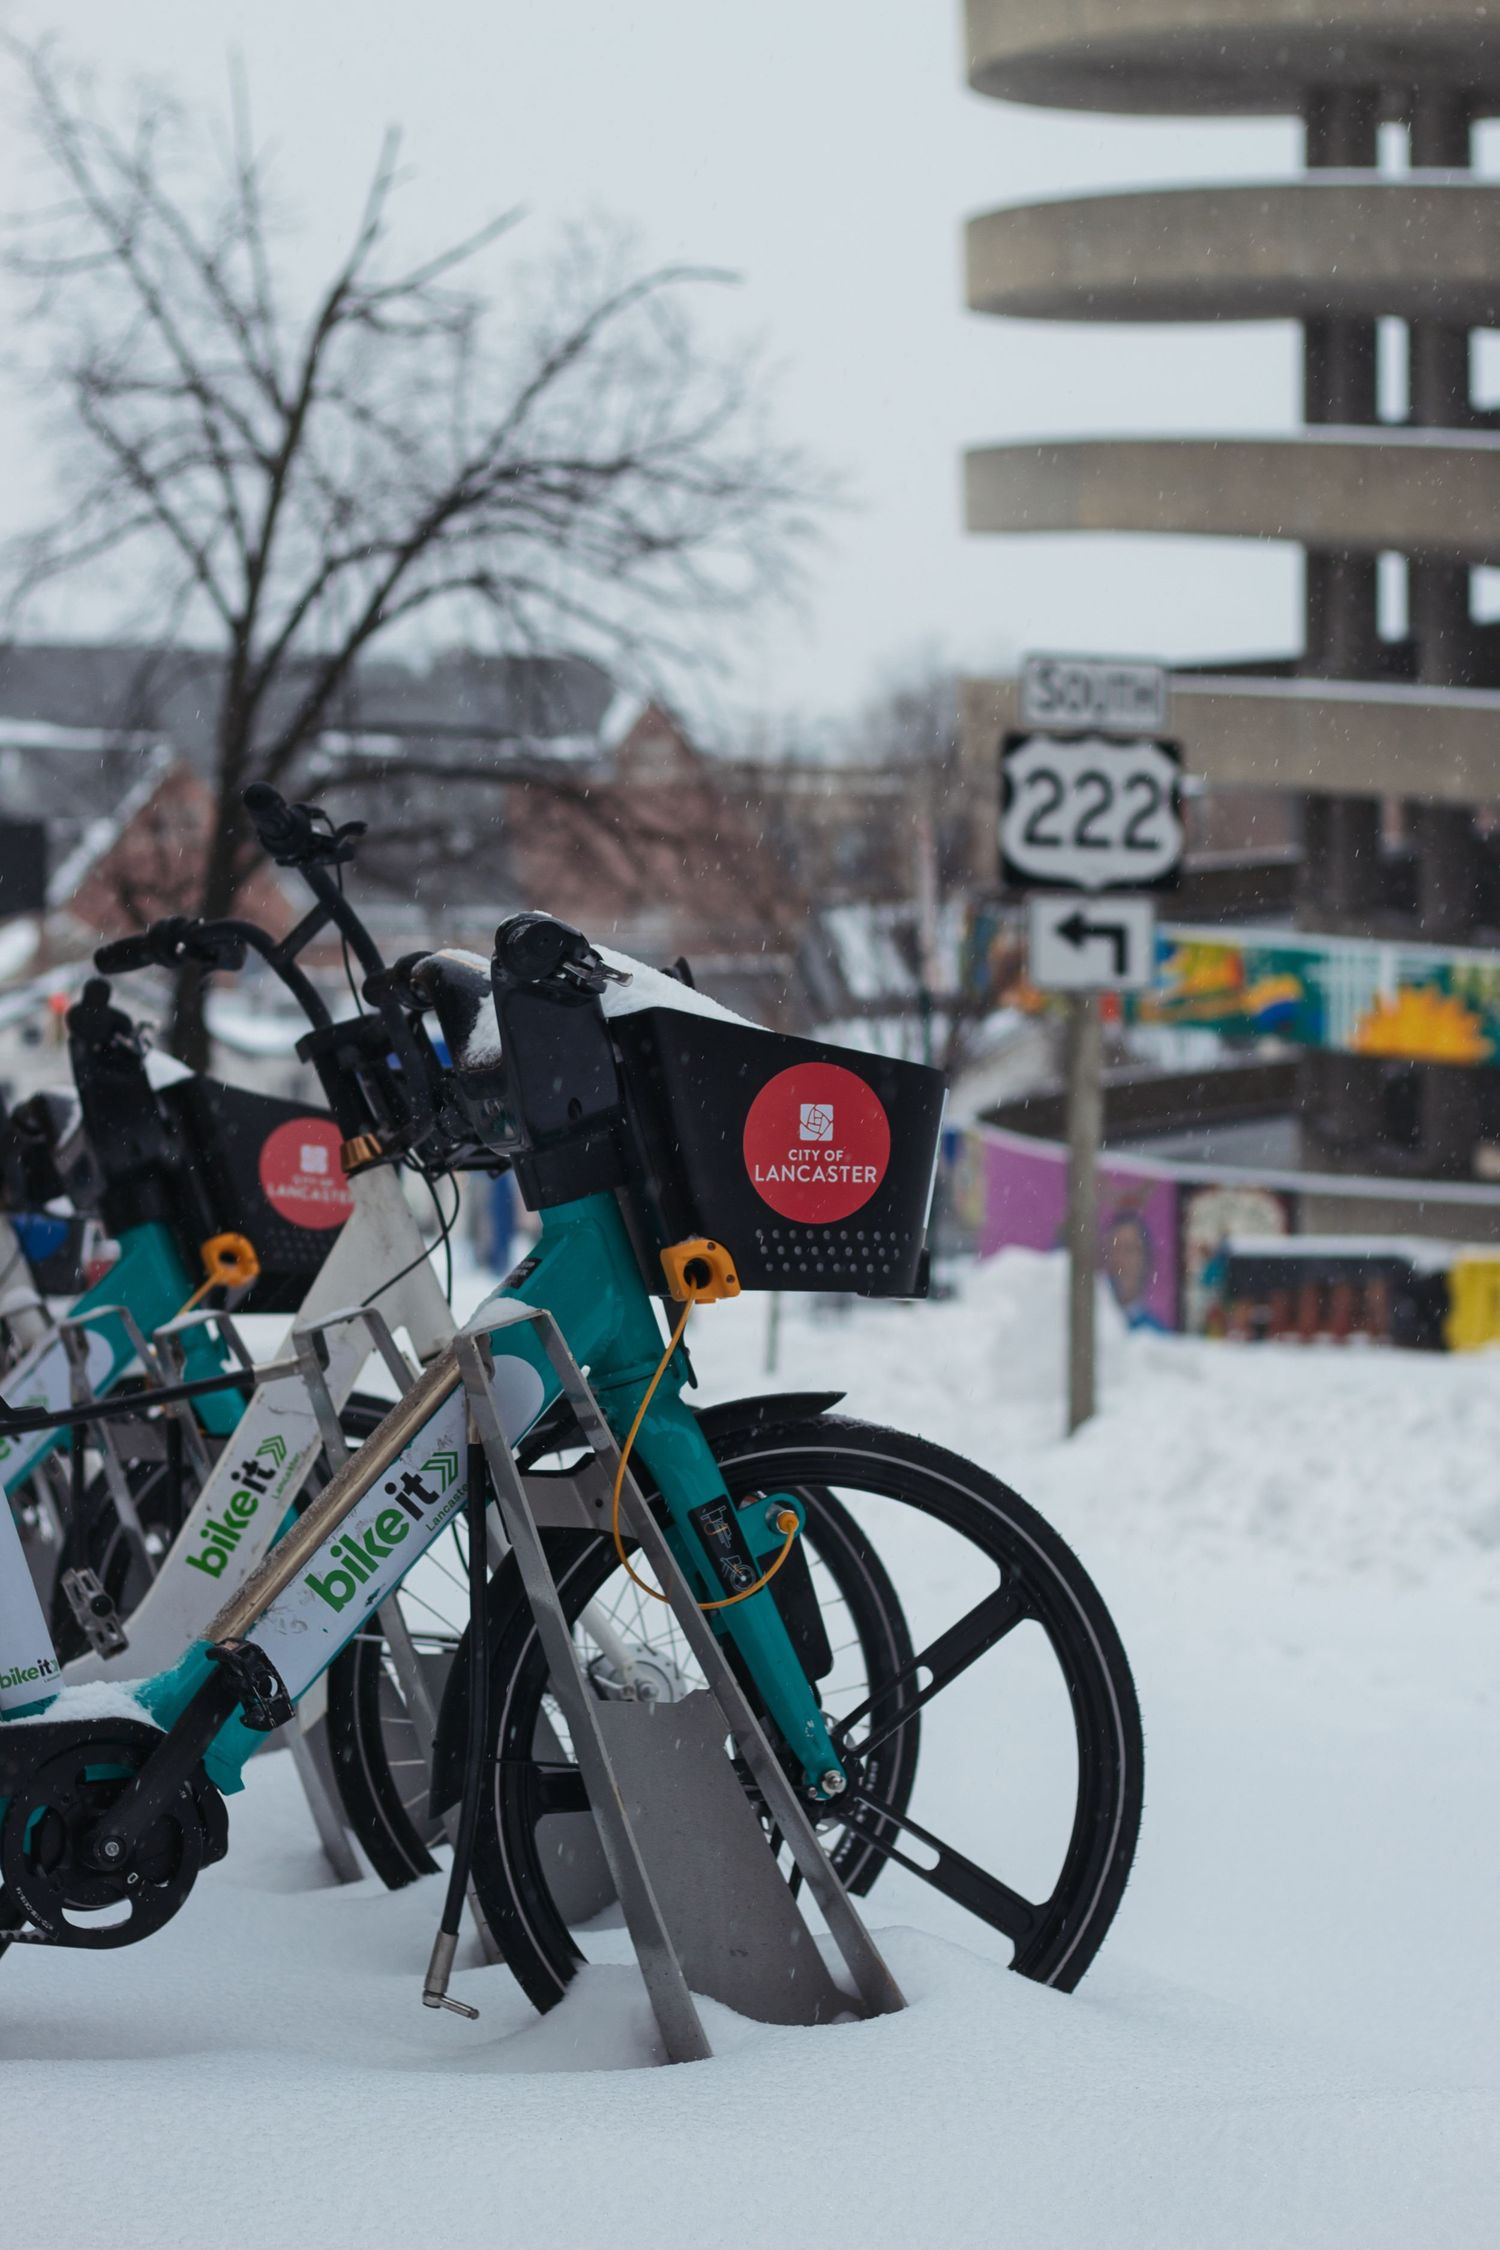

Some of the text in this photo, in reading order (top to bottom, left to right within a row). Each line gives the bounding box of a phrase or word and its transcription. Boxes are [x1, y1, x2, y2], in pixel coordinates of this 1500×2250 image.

[1035, 665, 1161, 714] SOUTH
[1023, 766, 1162, 850] 222
[754, 1164, 877, 1183] LANCASTER
[788, 1149, 844, 1161] CITY OF
[266, 1182, 353, 1204] LANCASTE
[184, 1459, 277, 1579] bikeit
[425, 1482, 470, 1532] Lancaste
[303, 1471, 440, 1614] bikeit
